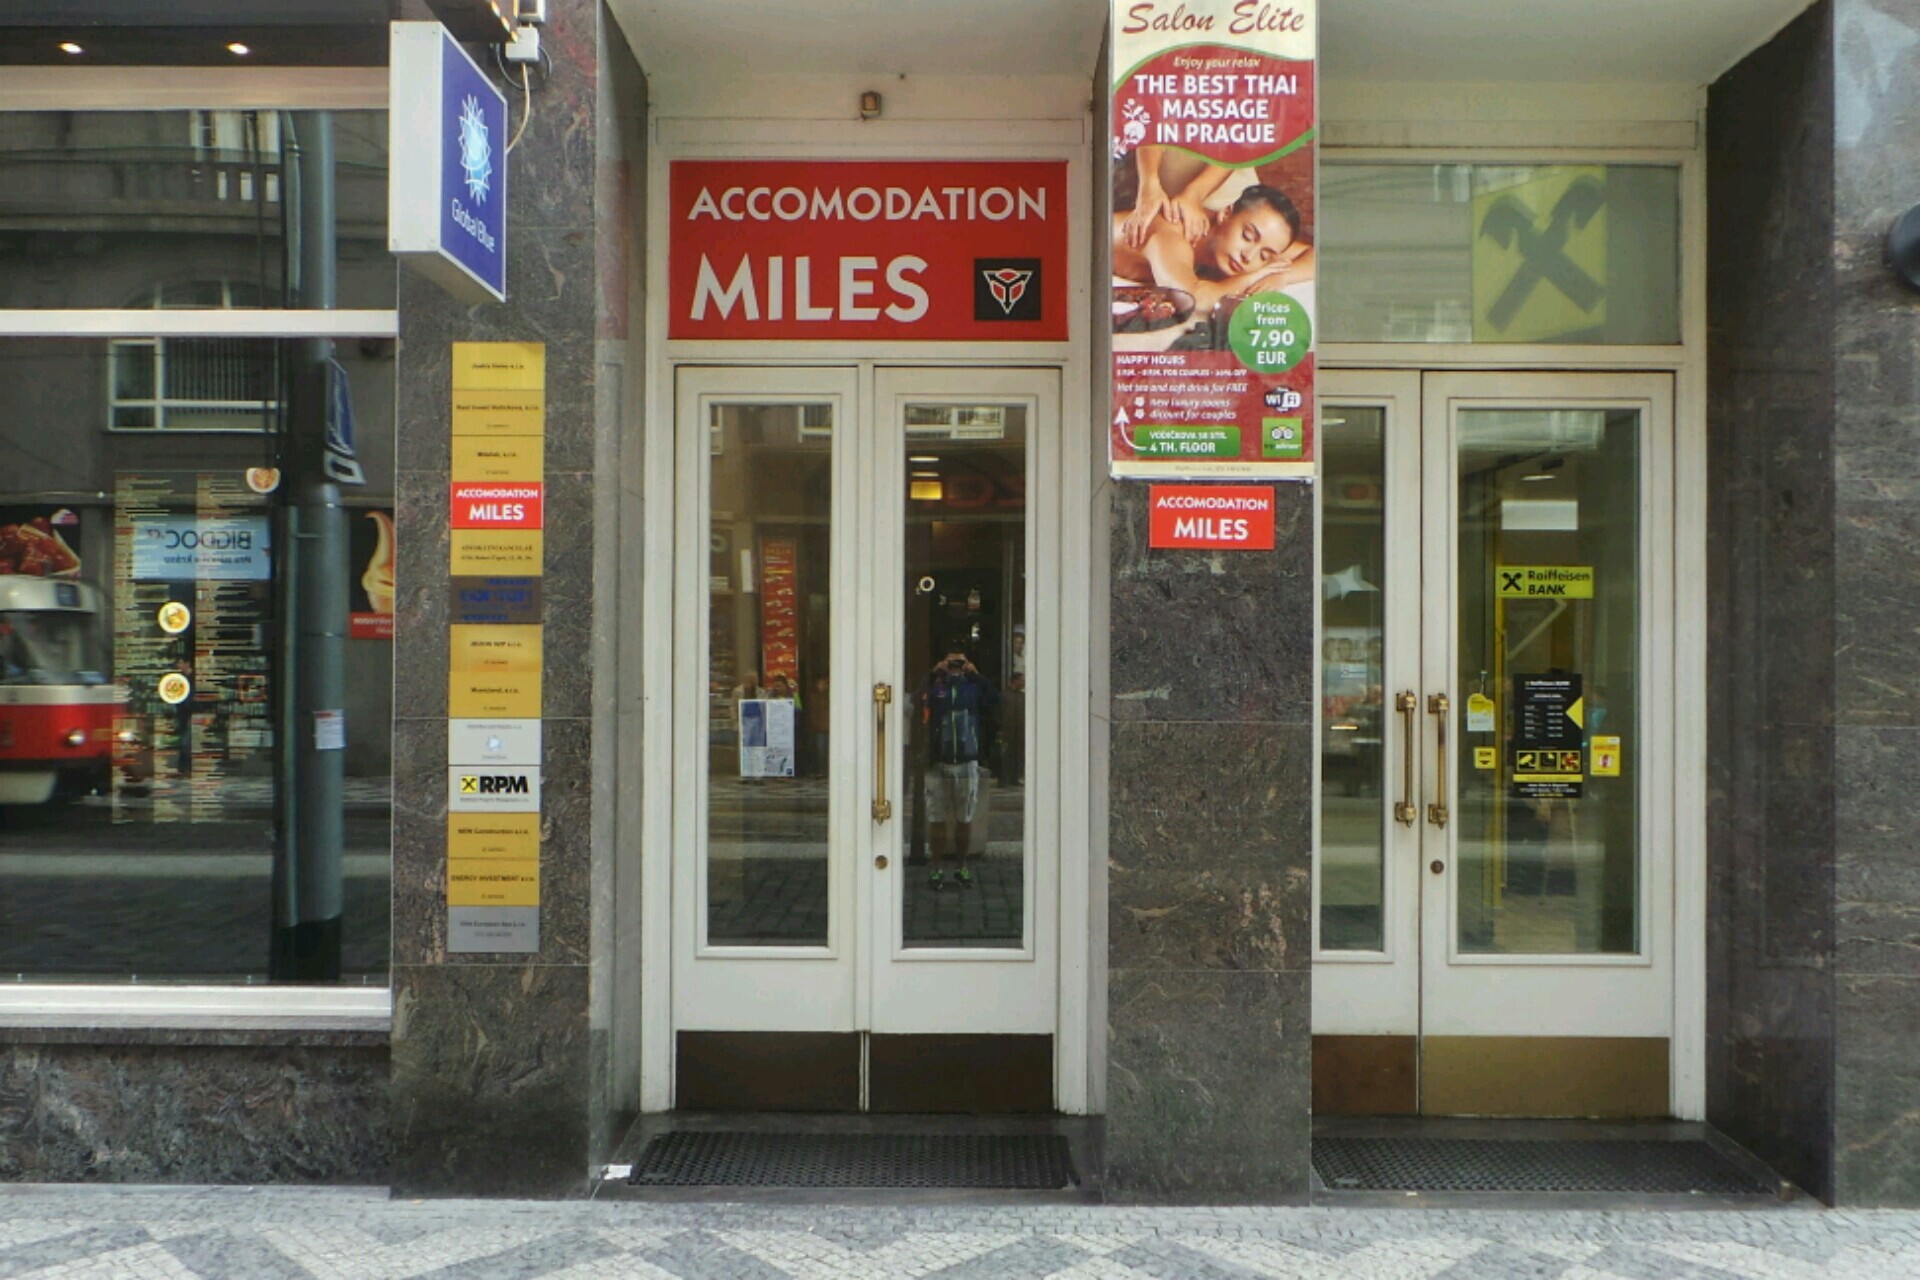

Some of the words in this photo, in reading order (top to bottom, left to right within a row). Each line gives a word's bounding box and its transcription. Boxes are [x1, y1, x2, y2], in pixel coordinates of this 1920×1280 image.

[1121, 2, 1214, 35] Salon
[1228, 0, 1305, 35] Elite
[1173, 56, 1201, 70] Enjoy
[1205, 58, 1230, 70] your
[1232, 56, 1261, 68] relax
[1134, 74, 1177, 95] THE
[1184, 74, 1238, 95] BEST
[1244, 74, 1297, 95] THAI
[1163, 99, 1269, 119] MASSAGE
[1156, 123, 1178, 143] IN
[1186, 123, 1275, 143] PRAGUE
[687, 185, 1046, 221] ACCOMODATION
[452, 198, 478, 237] Global
[478, 220, 494, 253] Blue
[689, 252, 930, 323] MILES
[1253, 301, 1291, 313] Prices
[1256, 313, 1287, 326] from
[1249, 329, 1295, 349] 7,90
[1116, 355, 1149, 365] HAPPY
[1151, 355, 1186, 365] HOURS
[1256, 351, 1287, 365] EUR
[1185, 409, 1200, 421] for
[1201, 409, 1237, 421] couples
[1149, 442, 1158, 453] 4
[1159, 442, 1178, 453] TH.
[1180, 442, 1216, 453] FLOOR
[456, 488, 539, 498] ACCOMODATION
[1156, 496, 1268, 511] ACCOMODATION
[468, 503, 525, 521] MILES
[1173, 516, 1249, 541] MILES
[1527, 570, 1591, 582] Raiffeisen
[1527, 584, 1567, 595] BANK
[479, 775, 529, 794] RPM
